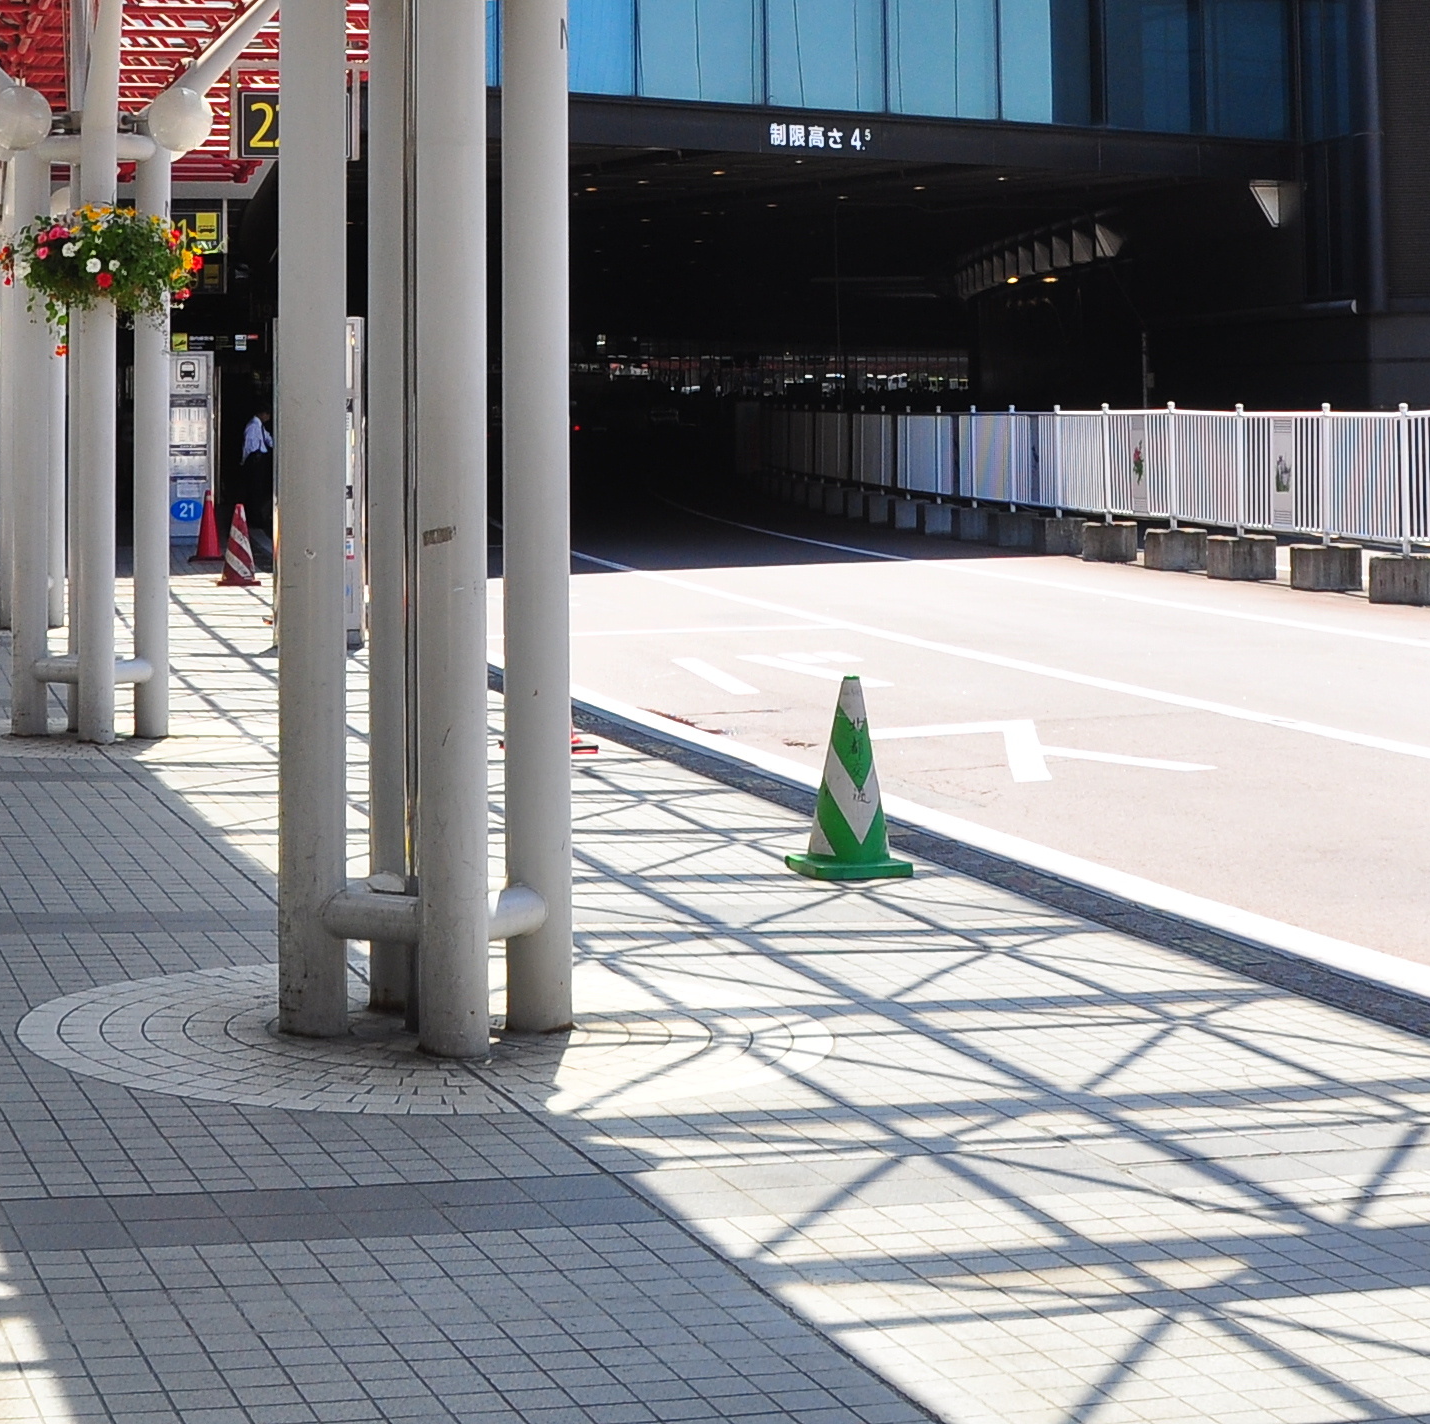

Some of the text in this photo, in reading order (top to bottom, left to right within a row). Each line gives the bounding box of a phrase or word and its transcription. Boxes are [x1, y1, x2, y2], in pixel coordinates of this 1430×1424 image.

[249, 102, 280, 148] 2
[769, 122, 844, 149] 制限高さ
[179, 502, 195, 518] 21
